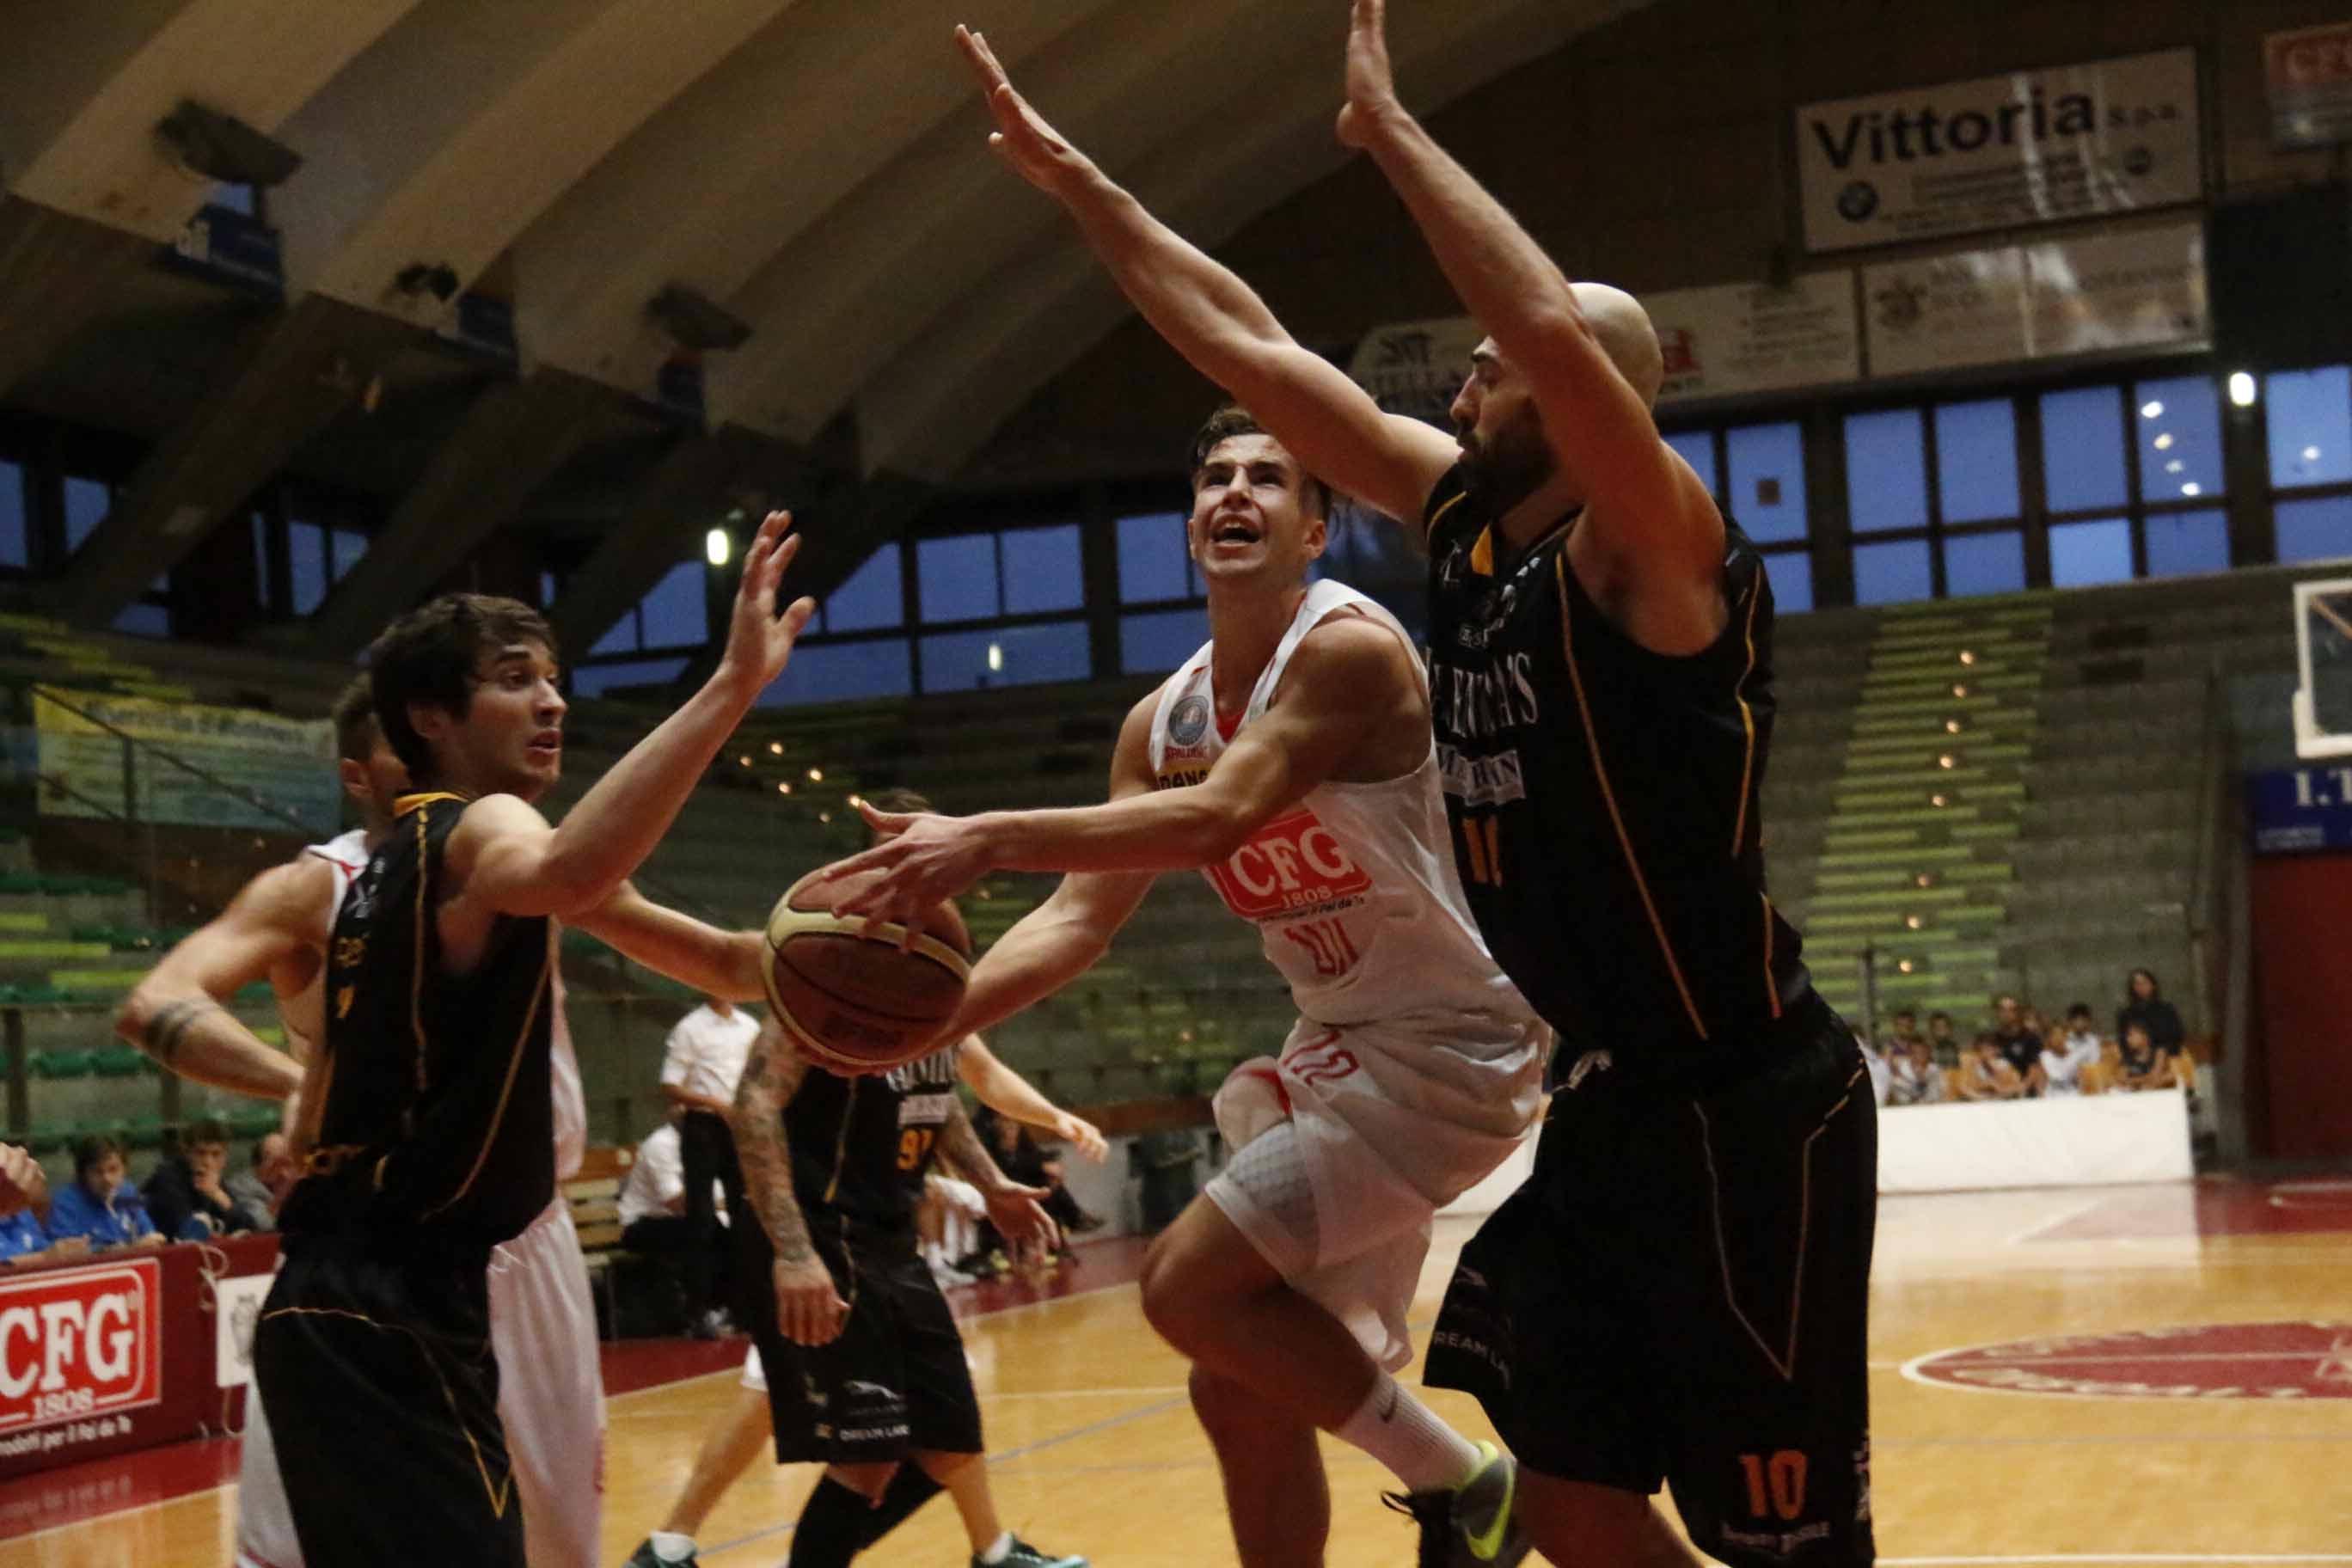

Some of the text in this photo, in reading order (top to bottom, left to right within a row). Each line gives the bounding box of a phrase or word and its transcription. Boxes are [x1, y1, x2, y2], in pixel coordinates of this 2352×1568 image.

[1812, 89, 2096, 169] Vittoria
[1229, 825, 1355, 897] CFG
[0, 1292, 134, 1400] CFG
[1736, 1449, 1808, 1520] 10
